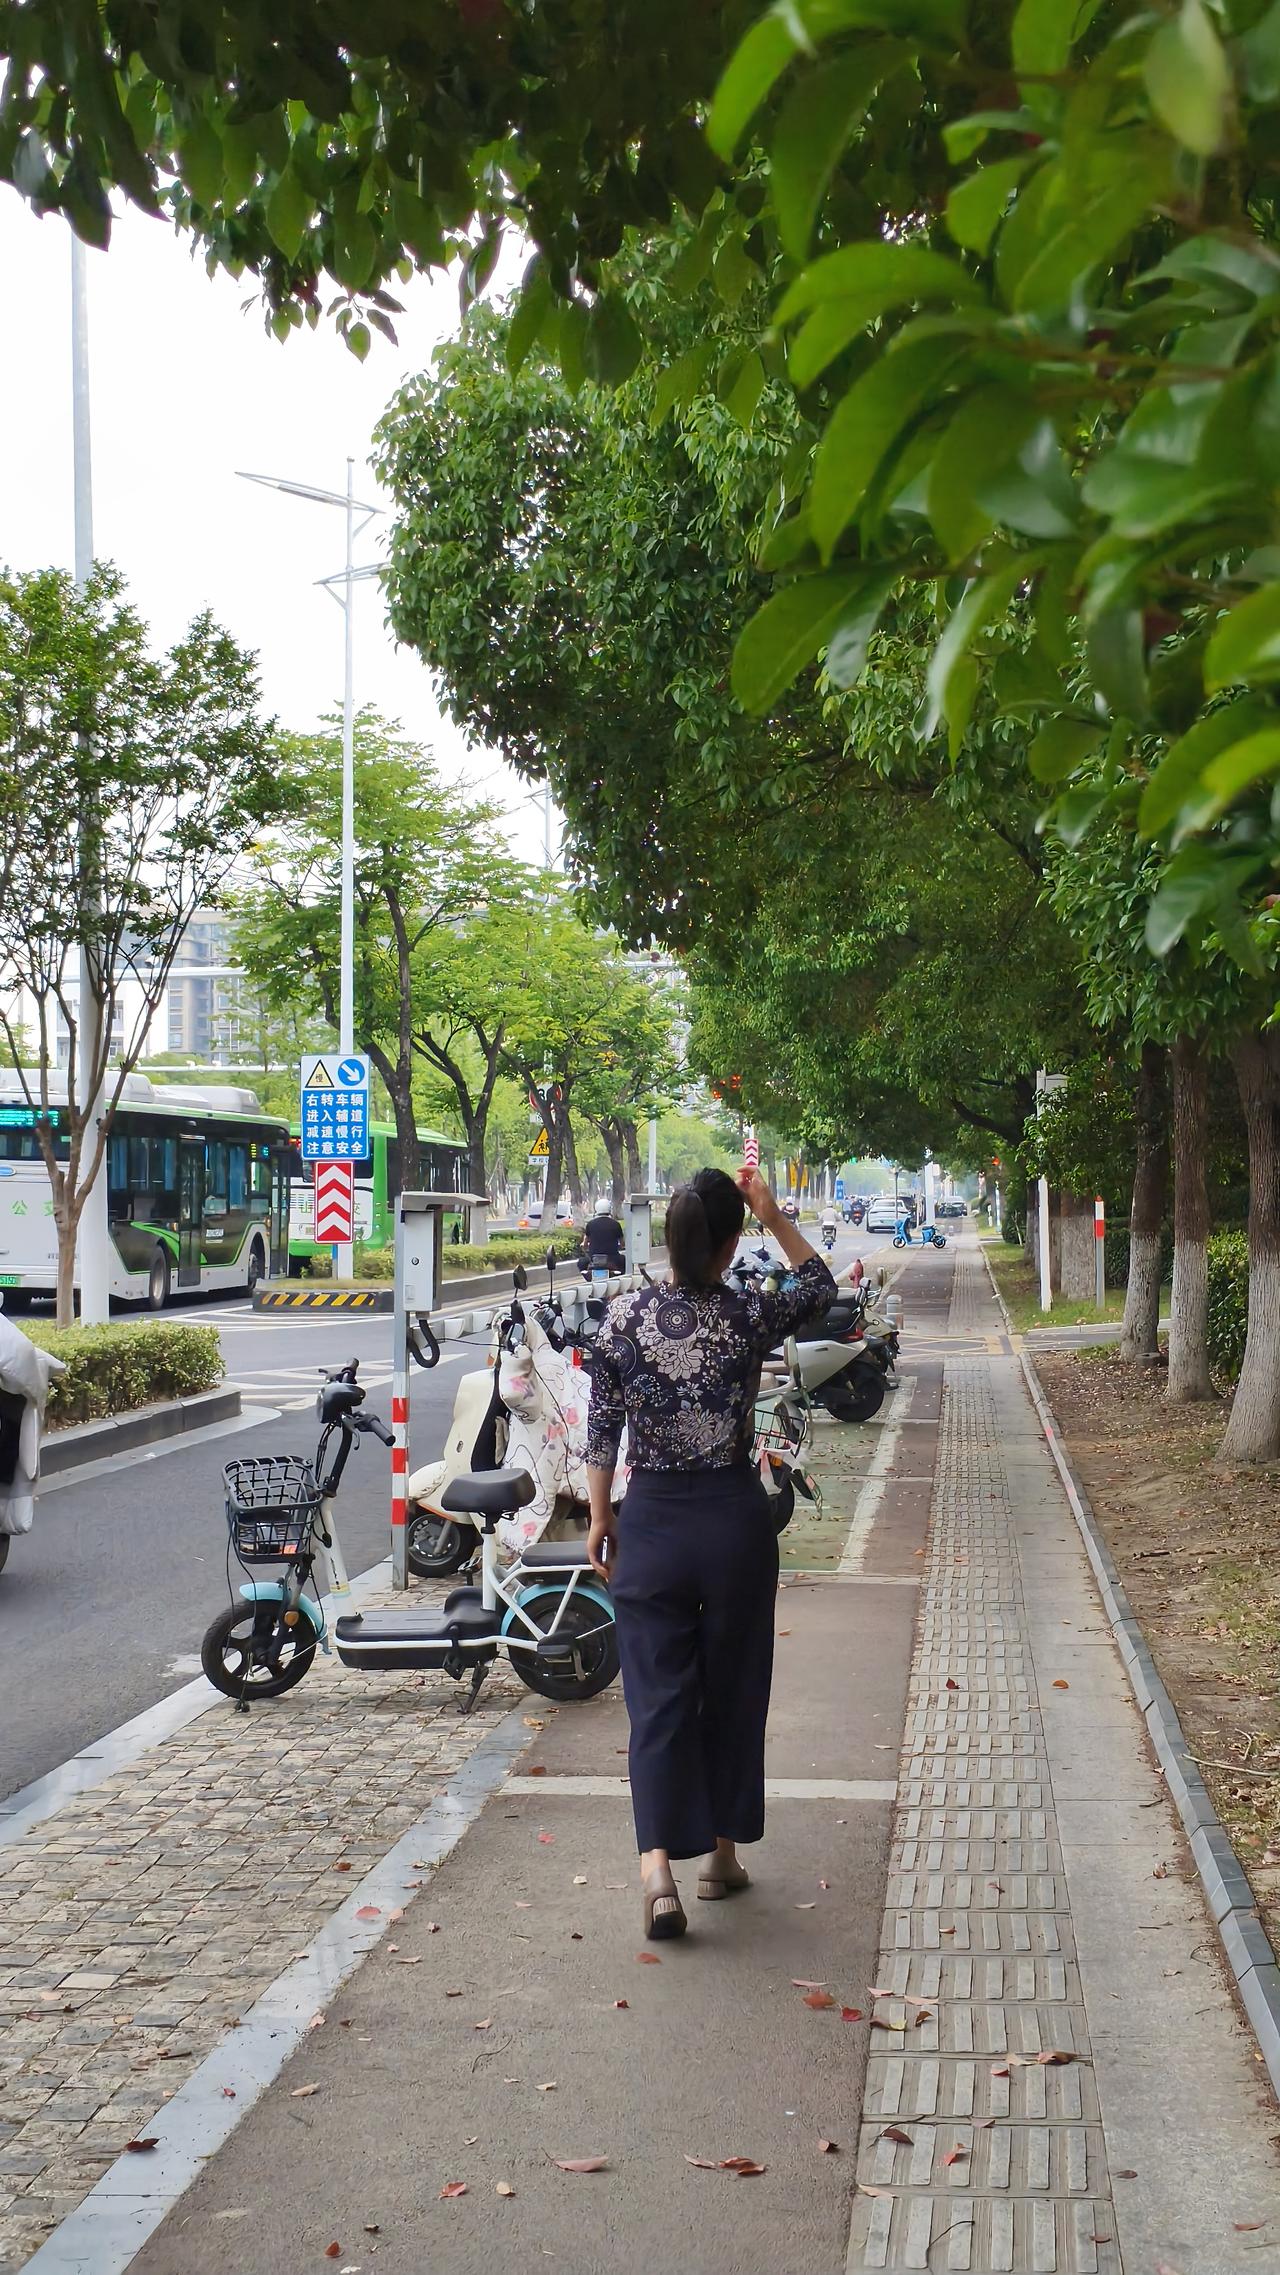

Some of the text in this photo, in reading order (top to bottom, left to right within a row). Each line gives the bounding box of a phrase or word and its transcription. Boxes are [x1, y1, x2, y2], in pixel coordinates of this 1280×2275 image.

[315, 1074, 324, 1083] 慢
[306, 1093, 364, 1106] 右转车辆
[306, 1109, 364, 1123] 进入辅道
[306, 1125, 364, 1139] 减速慢行
[306, 1141, 364, 1155] 注意安全
